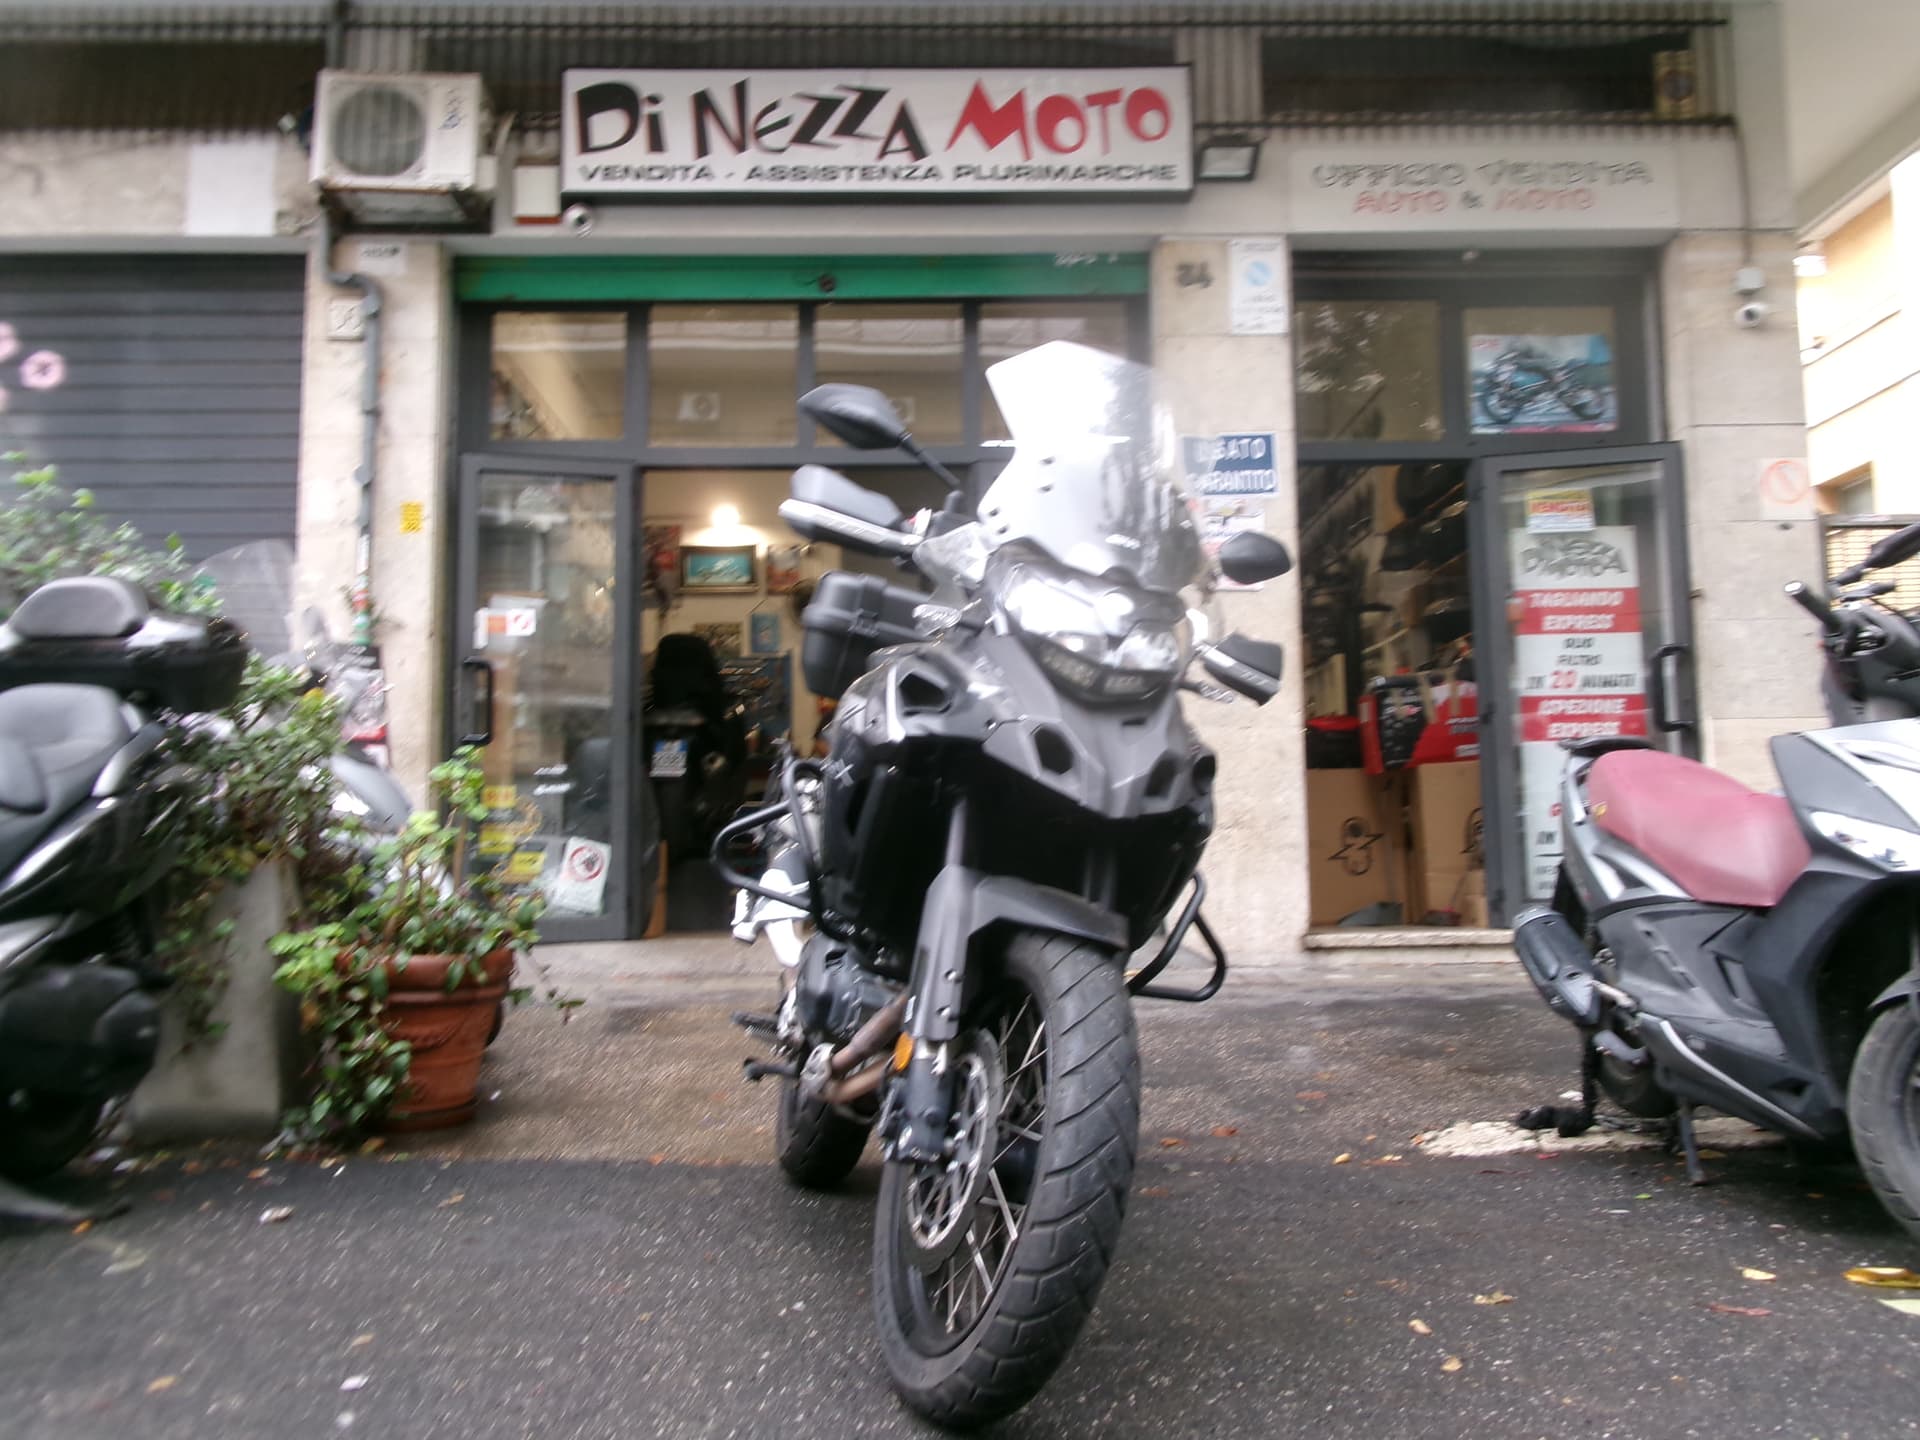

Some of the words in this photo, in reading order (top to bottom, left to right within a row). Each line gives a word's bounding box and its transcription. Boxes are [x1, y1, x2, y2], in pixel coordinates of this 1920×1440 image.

[945, 77, 1171, 161] MOTO
[579, 164, 714, 182] VENDITA
[745, 164, 942, 182] ASSISTENZA
[952, 163, 1178, 182] PLURIMARCHE
[1311, 162, 1464, 188] UFFICIO
[1353, 190, 1448, 213] AUTO
[1492, 187, 1595, 211] MOTO
[1529, 591, 1624, 608] TAGLIANDO
[1542, 613, 1616, 631] EXPRESS
[1549, 669, 1577, 689] 20
[1546, 721, 1621, 739] EXPRESS
